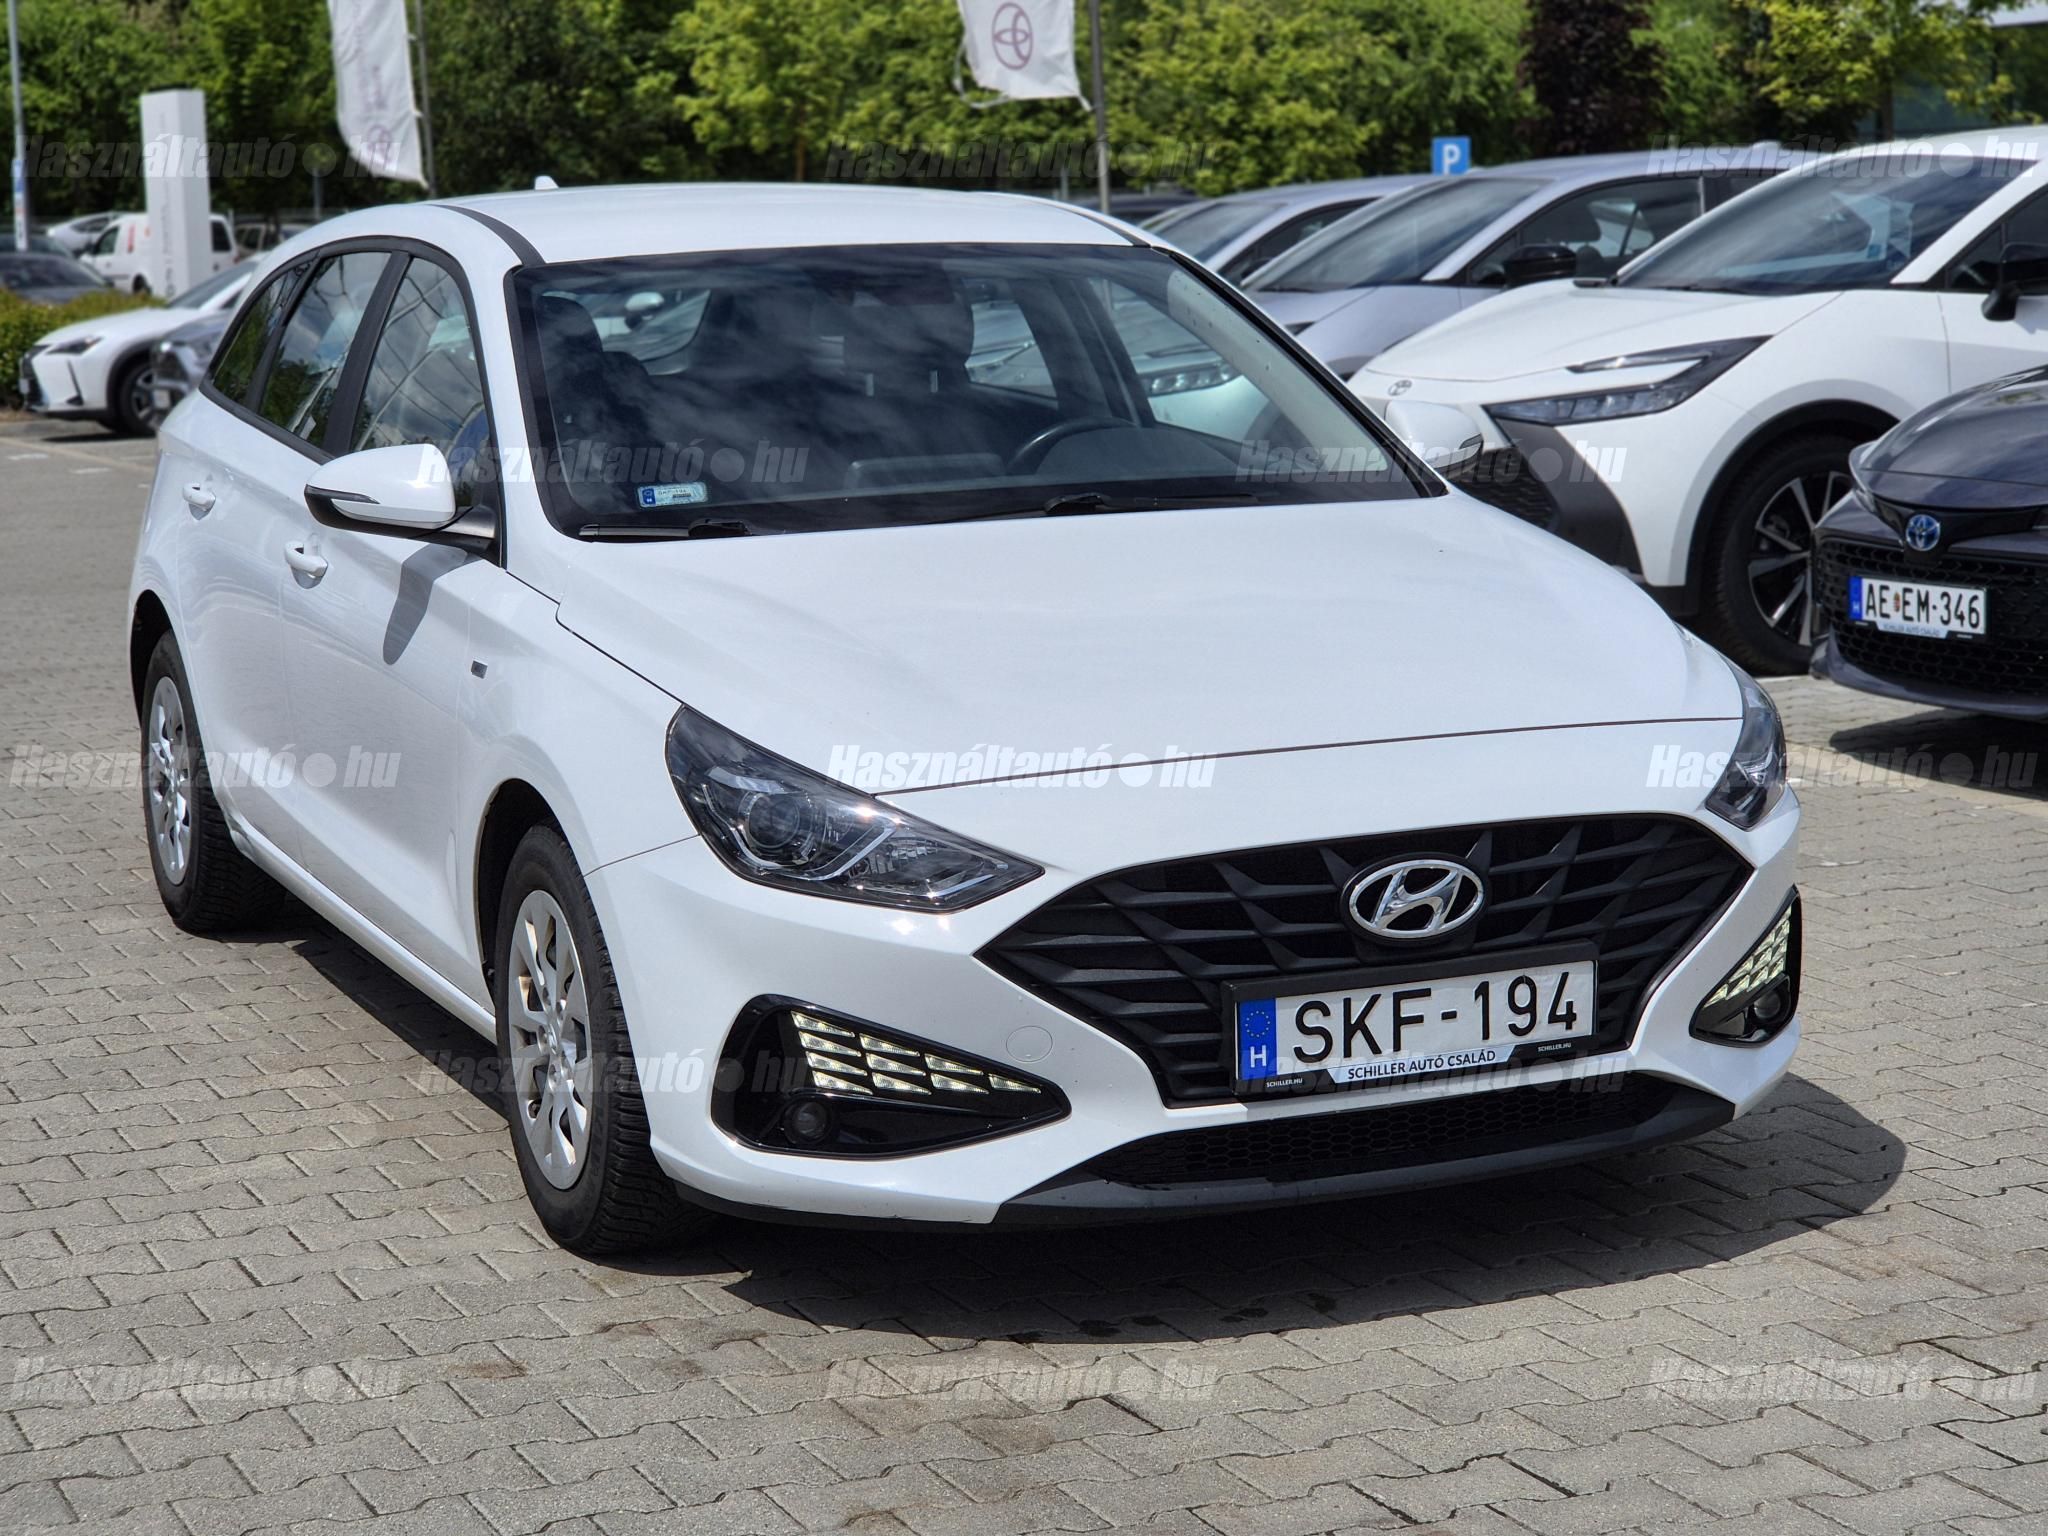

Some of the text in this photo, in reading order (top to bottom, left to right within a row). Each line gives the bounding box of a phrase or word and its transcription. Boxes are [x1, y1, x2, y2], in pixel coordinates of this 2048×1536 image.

[1443, 144, 1461, 174] P
[1293, 971, 1577, 1063] SKF-194
[1250, 1045, 1267, 1068] H
[1348, 1048, 1496, 1079] SCHILLER AUTÓ CSALÁD
